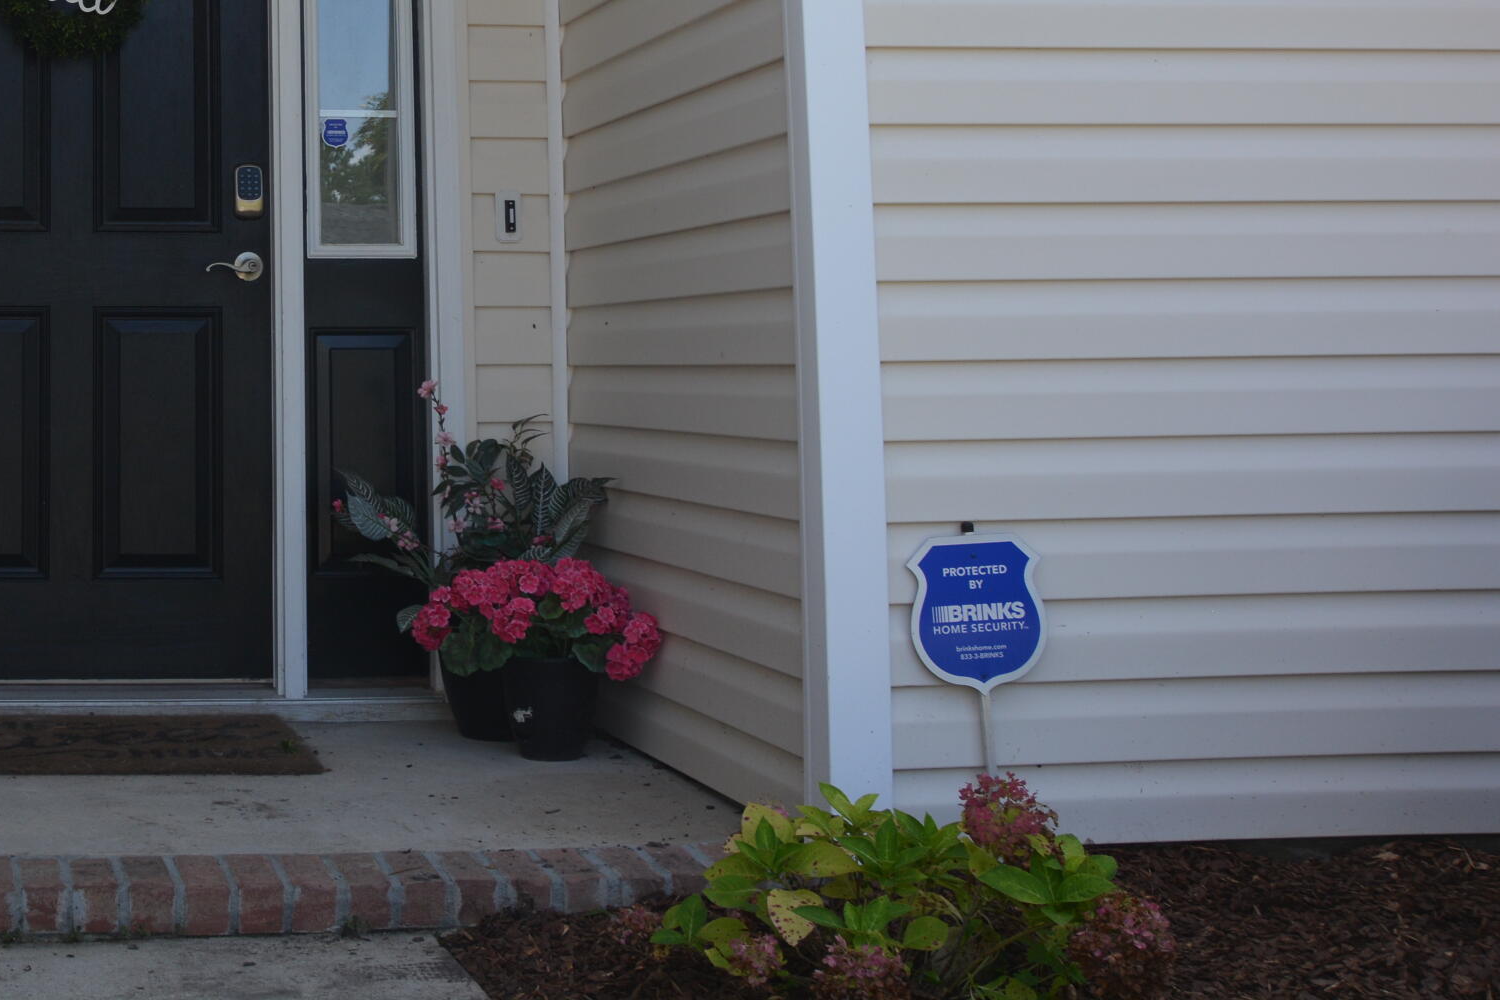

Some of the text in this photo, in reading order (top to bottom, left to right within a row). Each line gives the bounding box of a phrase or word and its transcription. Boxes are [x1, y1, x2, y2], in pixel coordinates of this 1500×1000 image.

[942, 565, 1007, 577] PROTECTED
[969, 579, 983, 589] BY
[947, 601, 1025, 623] BRINKS
[933, 621, 1025, 635] HOME SECURITY
[956, 644, 1007, 652] brinkshome.com
[960, 652, 1004, 660] 833-3-BRINKS
